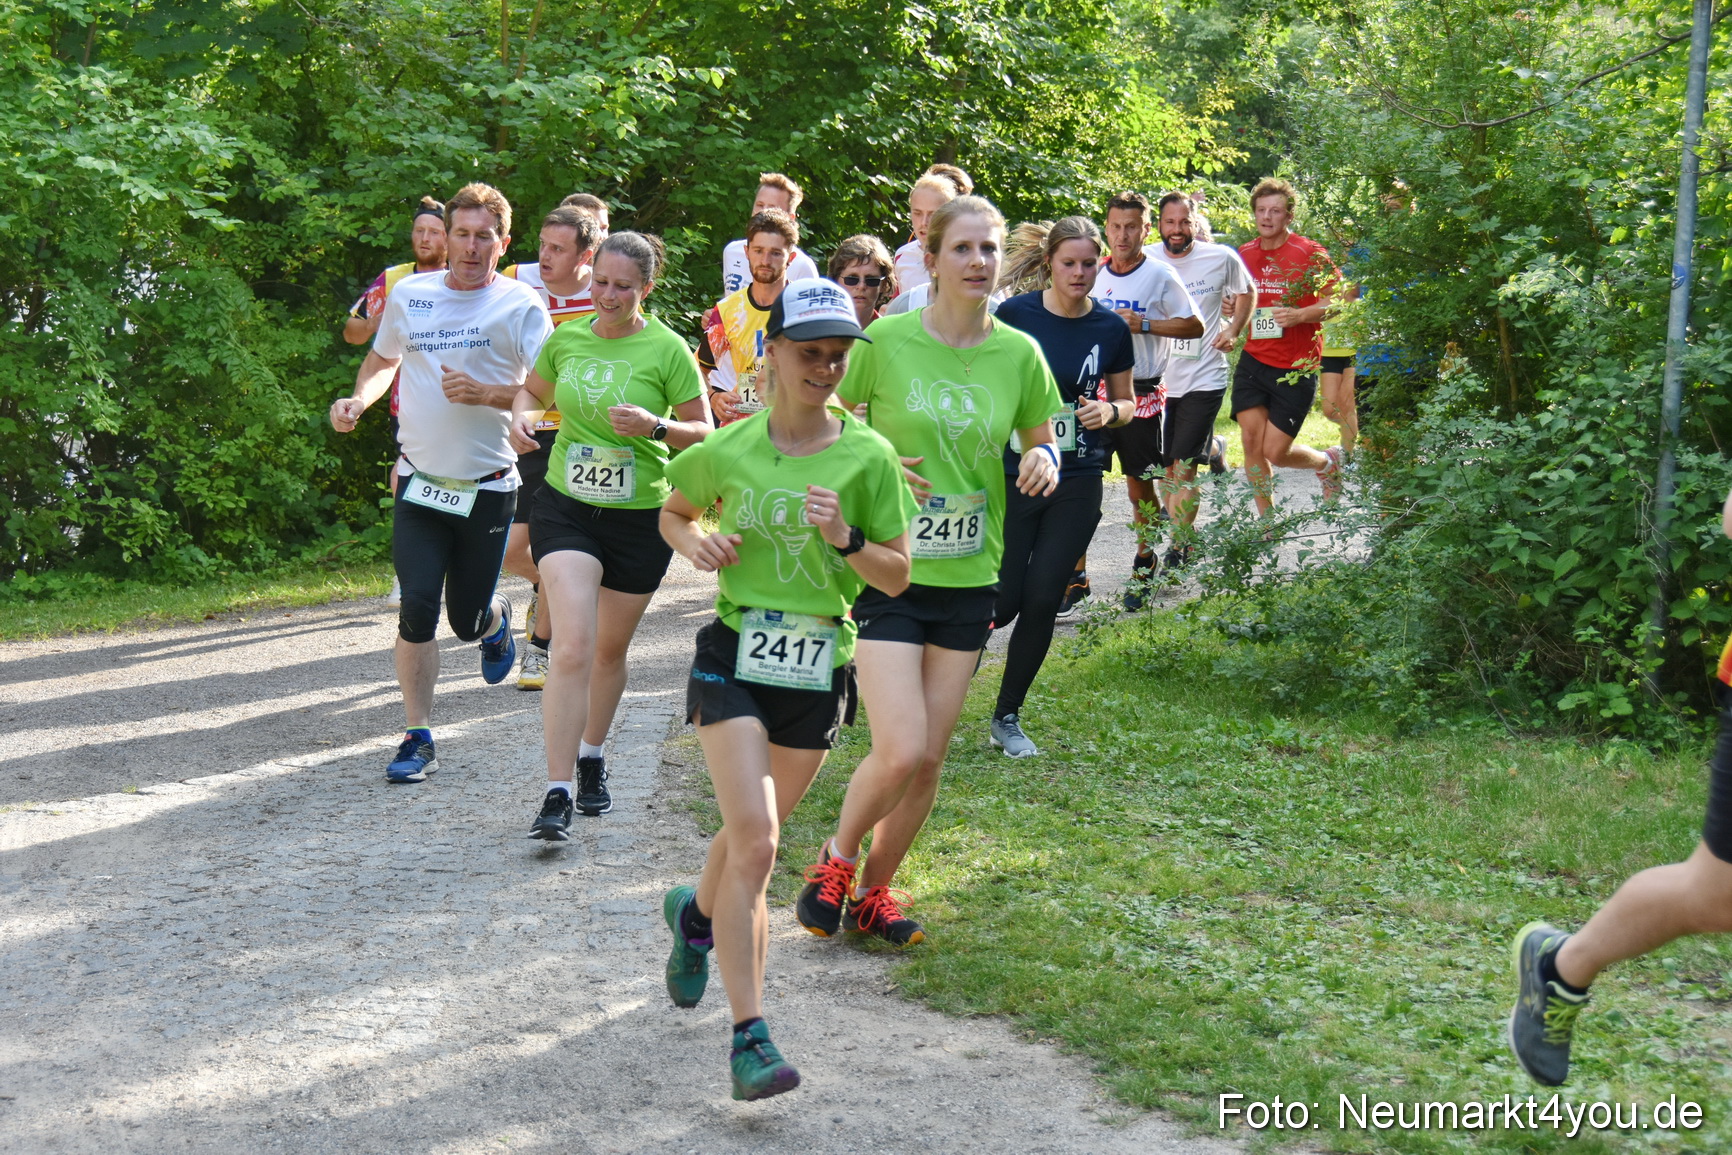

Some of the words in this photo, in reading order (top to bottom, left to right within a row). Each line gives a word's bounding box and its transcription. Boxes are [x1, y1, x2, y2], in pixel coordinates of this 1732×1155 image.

[797, 288, 845, 300] SILBER
[408, 299, 434, 309] DESS
[809, 298, 848, 309] PFEIL
[1256, 318, 1275, 331] 605
[409, 332, 435, 340] Unser
[438, 329, 465, 339] Sport
[467, 326, 480, 335] ist
[572, 464, 624, 488] 2421
[422, 486, 460, 506] 9130
[916, 515, 979, 540] 2418
[749, 631, 827, 666] 2417
[758, 661, 788, 672] Bergler
[790, 666, 814, 675] Marina
